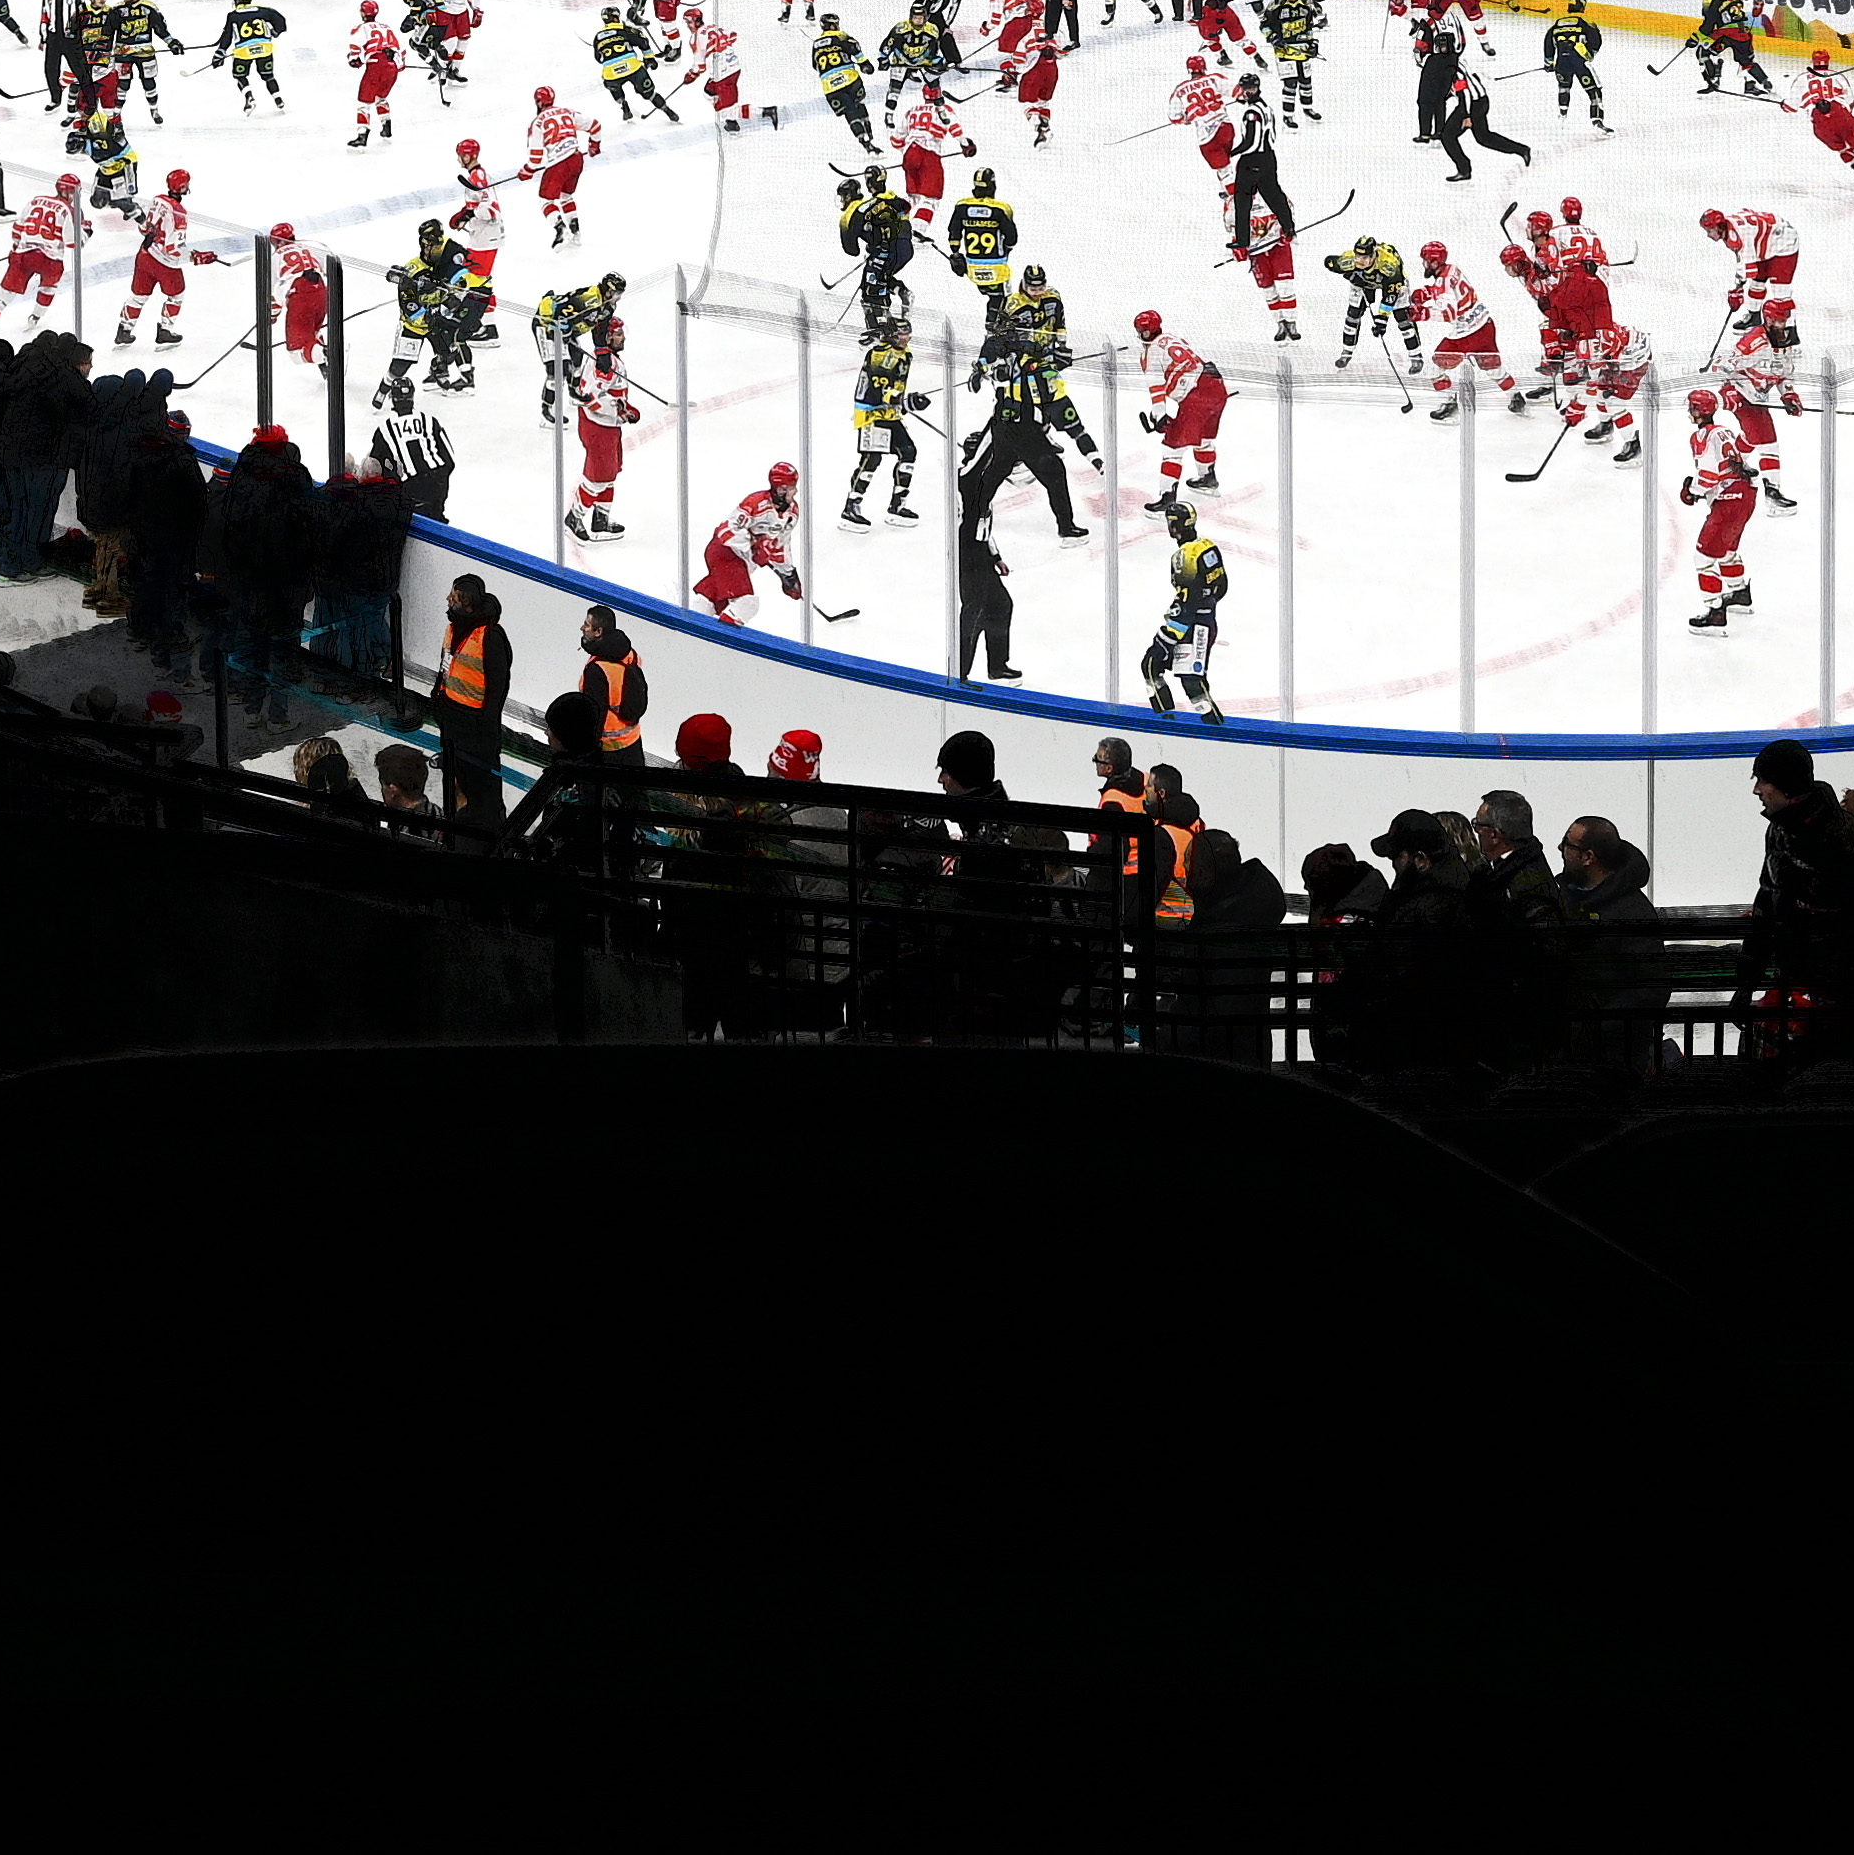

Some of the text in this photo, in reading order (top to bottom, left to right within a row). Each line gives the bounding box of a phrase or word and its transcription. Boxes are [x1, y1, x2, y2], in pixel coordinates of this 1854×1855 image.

[240, 19, 264, 38] 63
[818, 52, 842, 70] 98
[1809, 79, 1833, 100] 91
[966, 232, 996, 255] 29
[872, 376, 889, 388] 29
[394, 418, 422, 439] 140
[1717, 492, 1743, 501] CCM
